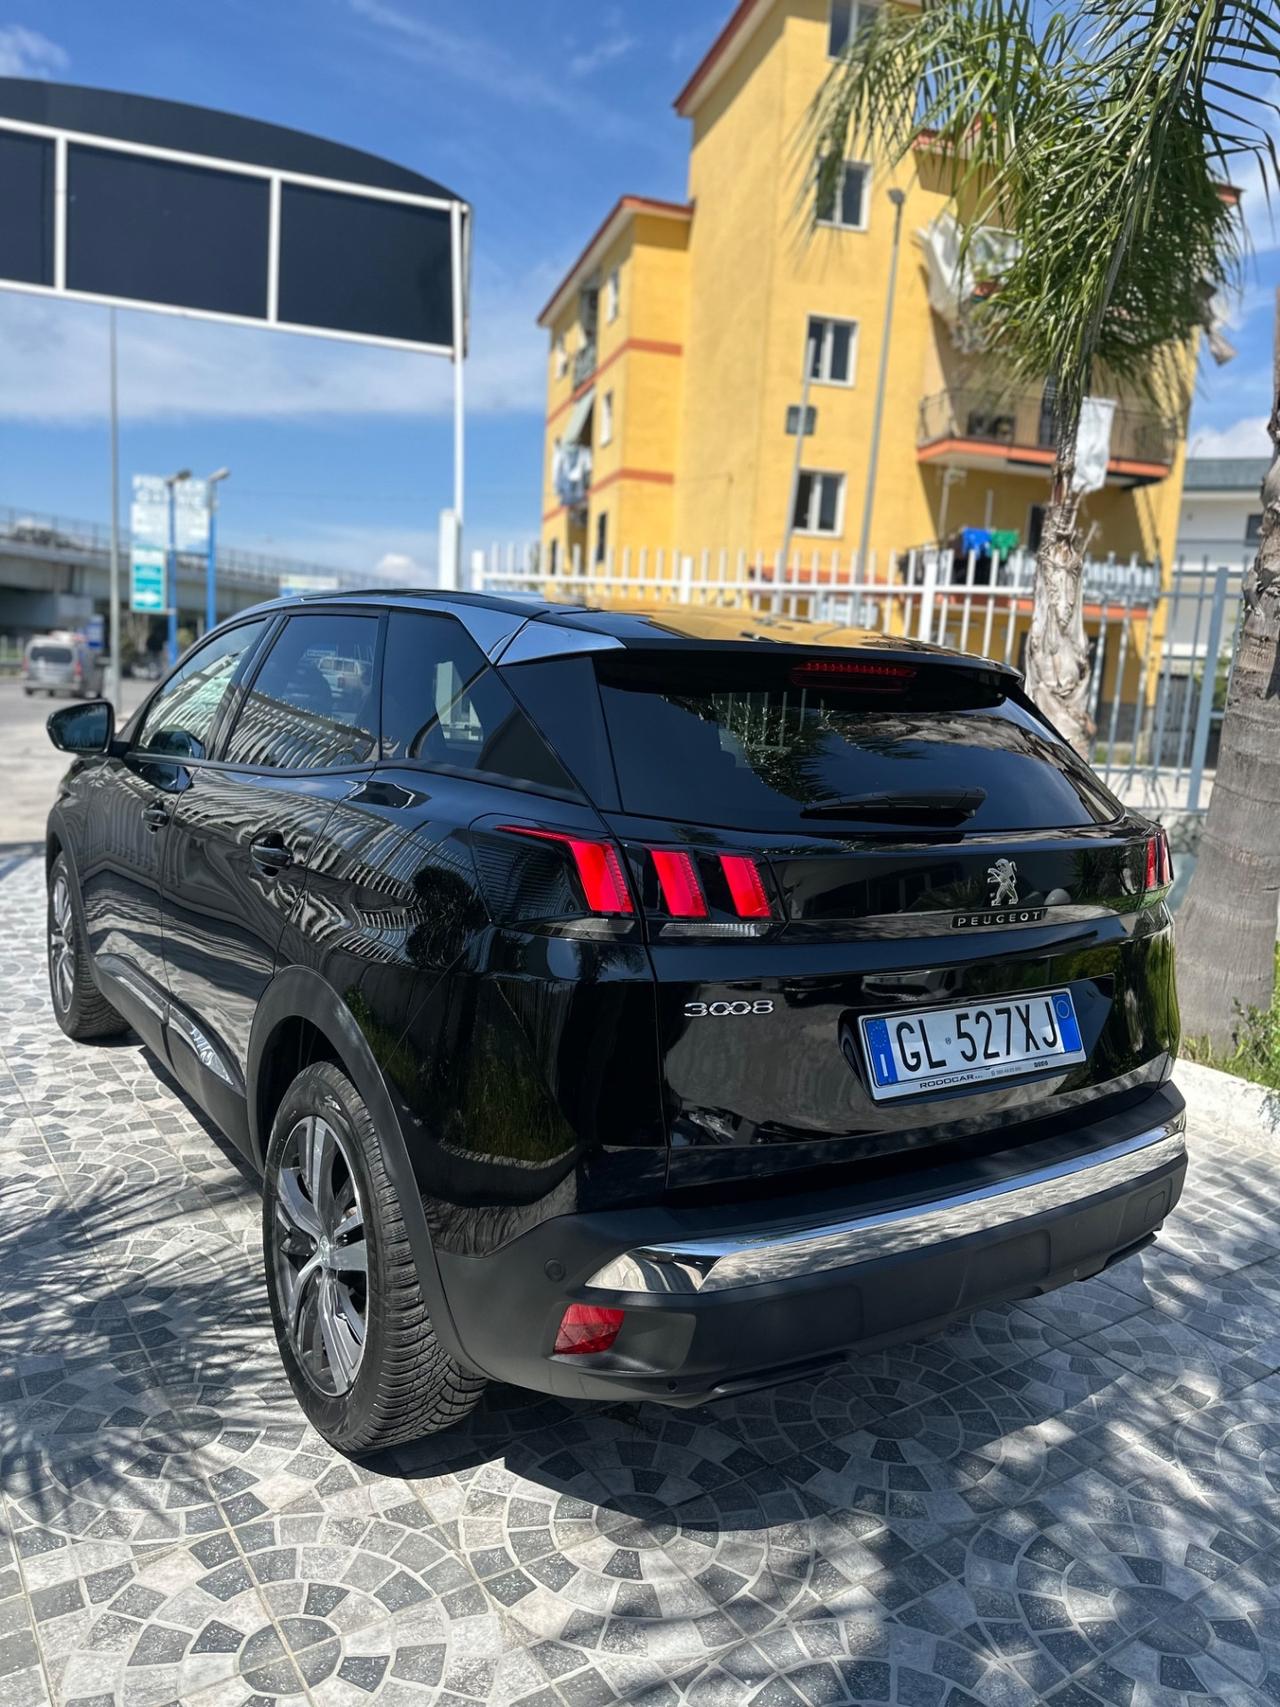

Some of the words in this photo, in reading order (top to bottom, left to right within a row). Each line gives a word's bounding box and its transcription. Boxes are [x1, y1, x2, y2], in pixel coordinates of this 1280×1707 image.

[957, 911, 1041, 927] PEUGEOT
[684, 1000, 775, 1017] 3008
[896, 1019, 947, 1072] GL
[955, 1001, 1058, 1062] 527XJ
[919, 1074, 975, 1089] RODOCAR
